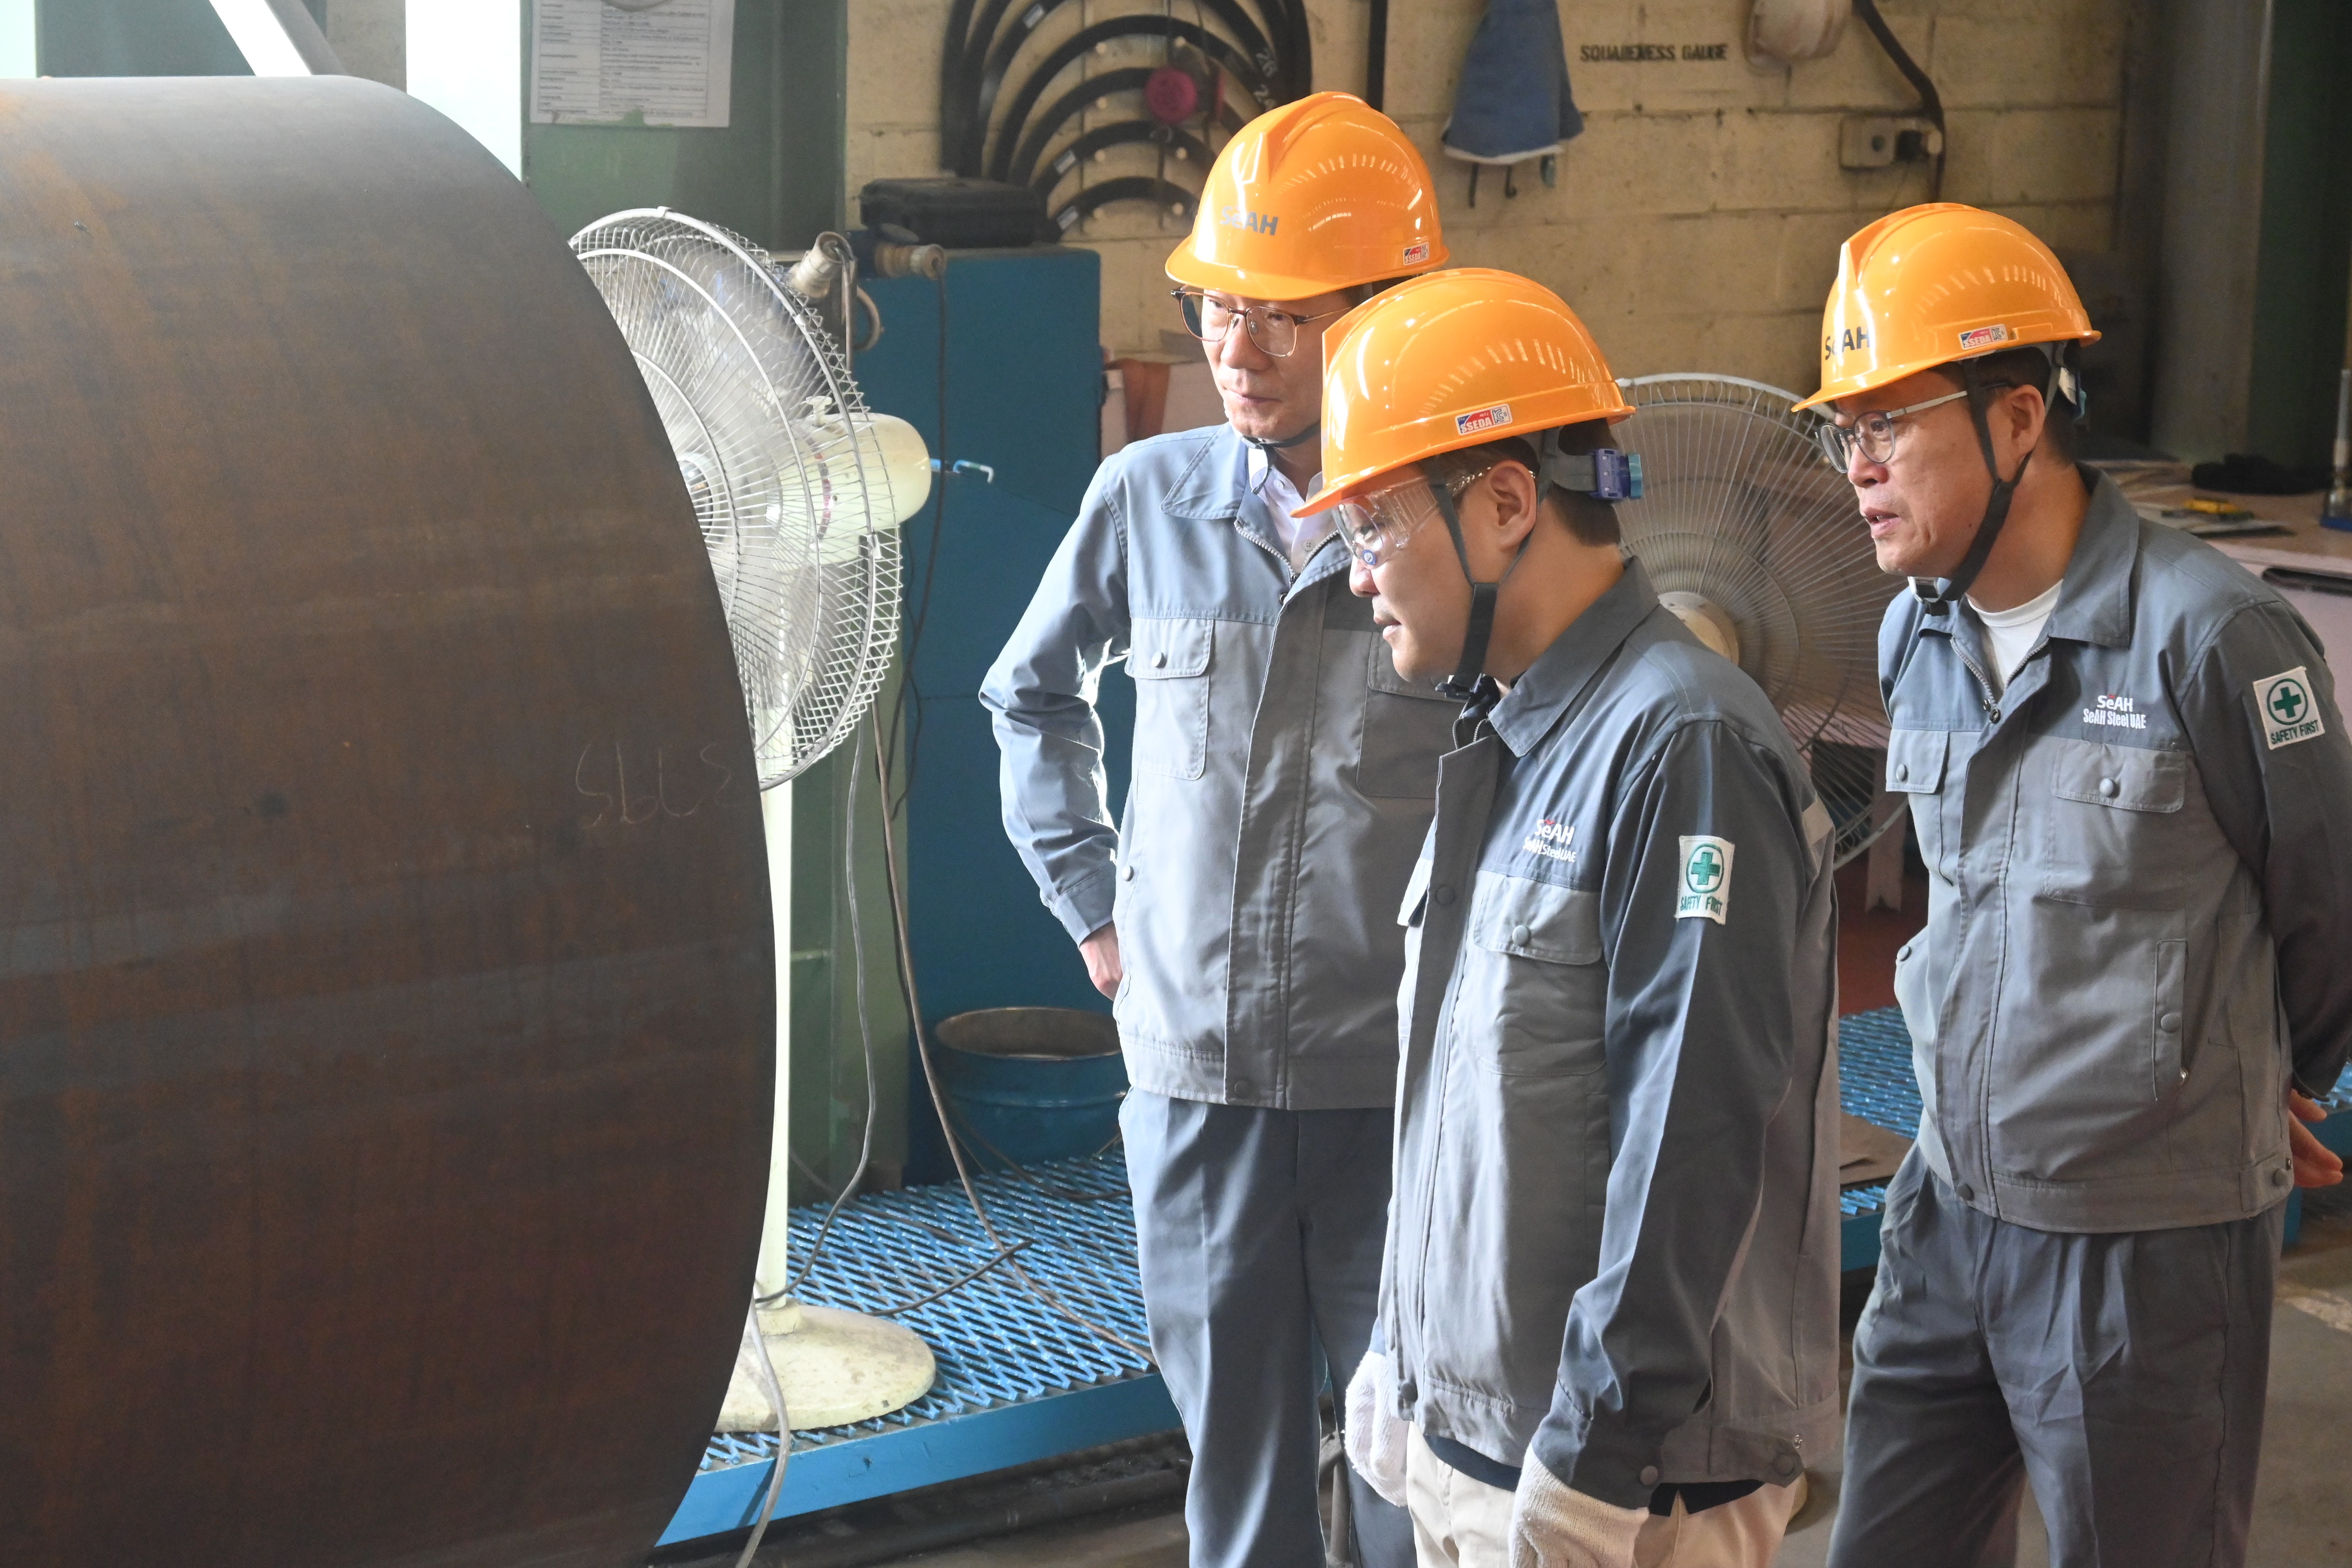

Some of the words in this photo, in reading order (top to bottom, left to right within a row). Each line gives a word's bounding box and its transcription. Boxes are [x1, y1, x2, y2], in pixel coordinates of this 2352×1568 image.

[2096, 695, 2133, 712] SeAH
[2083, 708, 2106, 725] SeAH
[2107, 710, 2129, 728] Steel
[2130, 713, 2147, 729] UAE
[2270, 726, 2298, 745] SAFETY
[2299, 719, 2319, 737] FIRST
[1534, 819, 1575, 845] SeAH
[1680, 895, 1701, 911] SAFETY
